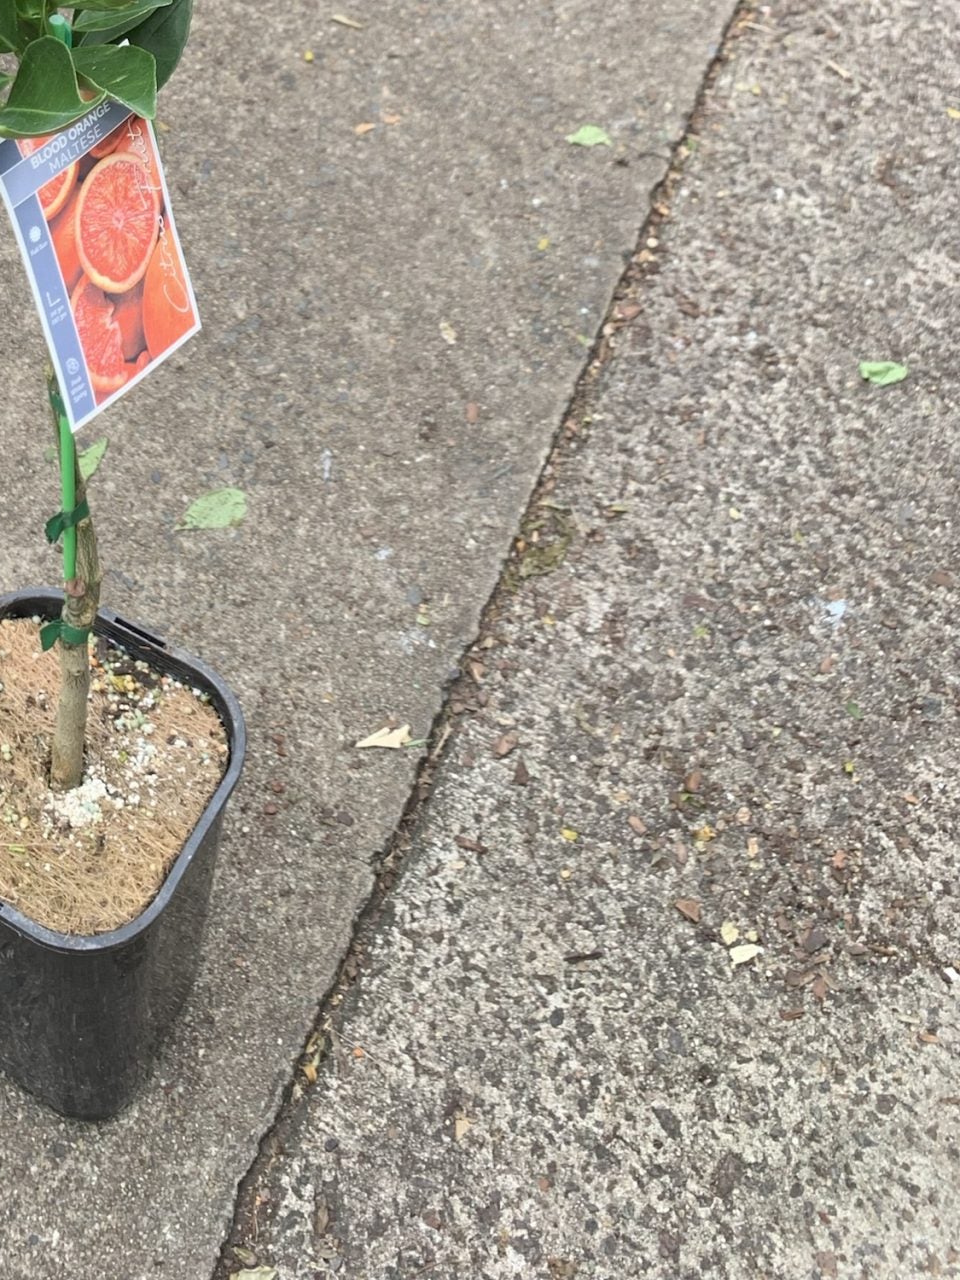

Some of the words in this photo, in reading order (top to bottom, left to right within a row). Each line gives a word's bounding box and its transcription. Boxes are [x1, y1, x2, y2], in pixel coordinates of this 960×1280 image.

[29, 138, 68, 170] BLOOD
[67, 101, 112, 140] ORANGE
[48, 123, 103, 174] MALTESE
[127, 118, 162, 211] Fruit
[159, 215, 190, 313] Citrus
